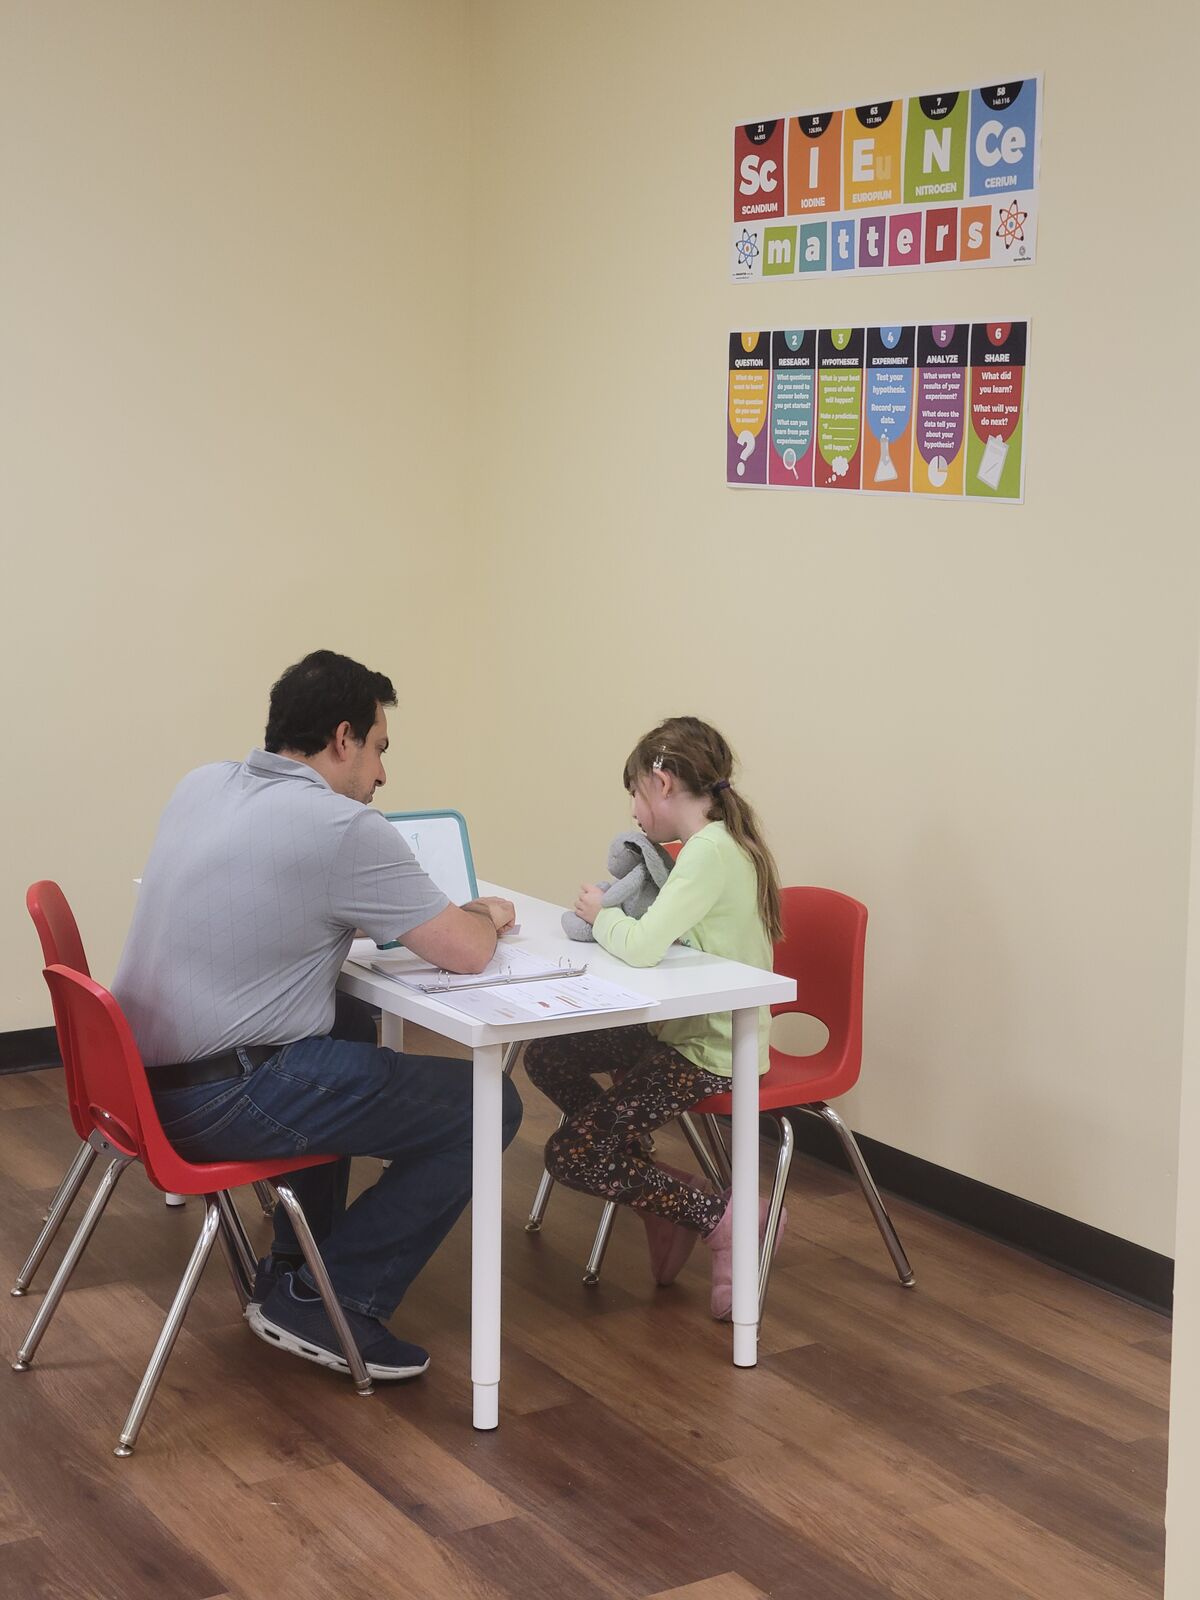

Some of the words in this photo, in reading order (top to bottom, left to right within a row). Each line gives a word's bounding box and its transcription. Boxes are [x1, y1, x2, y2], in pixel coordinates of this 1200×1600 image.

[997, 87, 1006, 96] 58
[936, 98, 942, 106] 7
[870, 107, 878, 115] 63
[812, 117, 819, 125] 53
[758, 125, 764, 133] 21
[739, 155, 777, 195] Sc
[809, 147, 819, 189] I
[923, 128, 952, 173] N
[976, 120, 1026, 167] Ce
[985, 175, 1017, 188] CERIUM
[915, 182, 957, 196] NITROGEN
[852, 190, 892, 203] EUROPIUM
[801, 197, 825, 208] IODINE
[741, 203, 778, 215] SCANDIUM
[767, 222, 984, 264] matters
[887, 332, 894, 342] 4
[940, 330, 946, 341] 5
[995, 328, 1001, 339] 6
[747, 337, 751, 346] 1
[792, 335, 797, 345] 2
[838, 334, 843, 344] 3
[779, 358, 809, 366] RESEARCH
[822, 358, 859, 366] HYPOTHESIZE
[872, 357, 908, 365] EXPERIMENT
[926, 355, 958, 364] ANALYZE
[985, 354, 1010, 363] SHARE
[735, 359, 763, 368] QUESTION
[876, 373, 889, 381] Test
[890, 373, 903, 382] your
[982, 372, 999, 380] What
[1000, 372, 1011, 380] did
[873, 386, 906, 394] hypothesis.
[980, 387, 992, 395] you
[993, 385, 1012, 393] learn?
[871, 404, 890, 412] Record
[891, 404, 906, 413] your
[973, 404, 991, 412] What
[992, 404, 1004, 412] will
[1005, 406, 1018, 414] you
[880, 416, 895, 424] data.
[924, 441, 954, 449] hypothesis?
